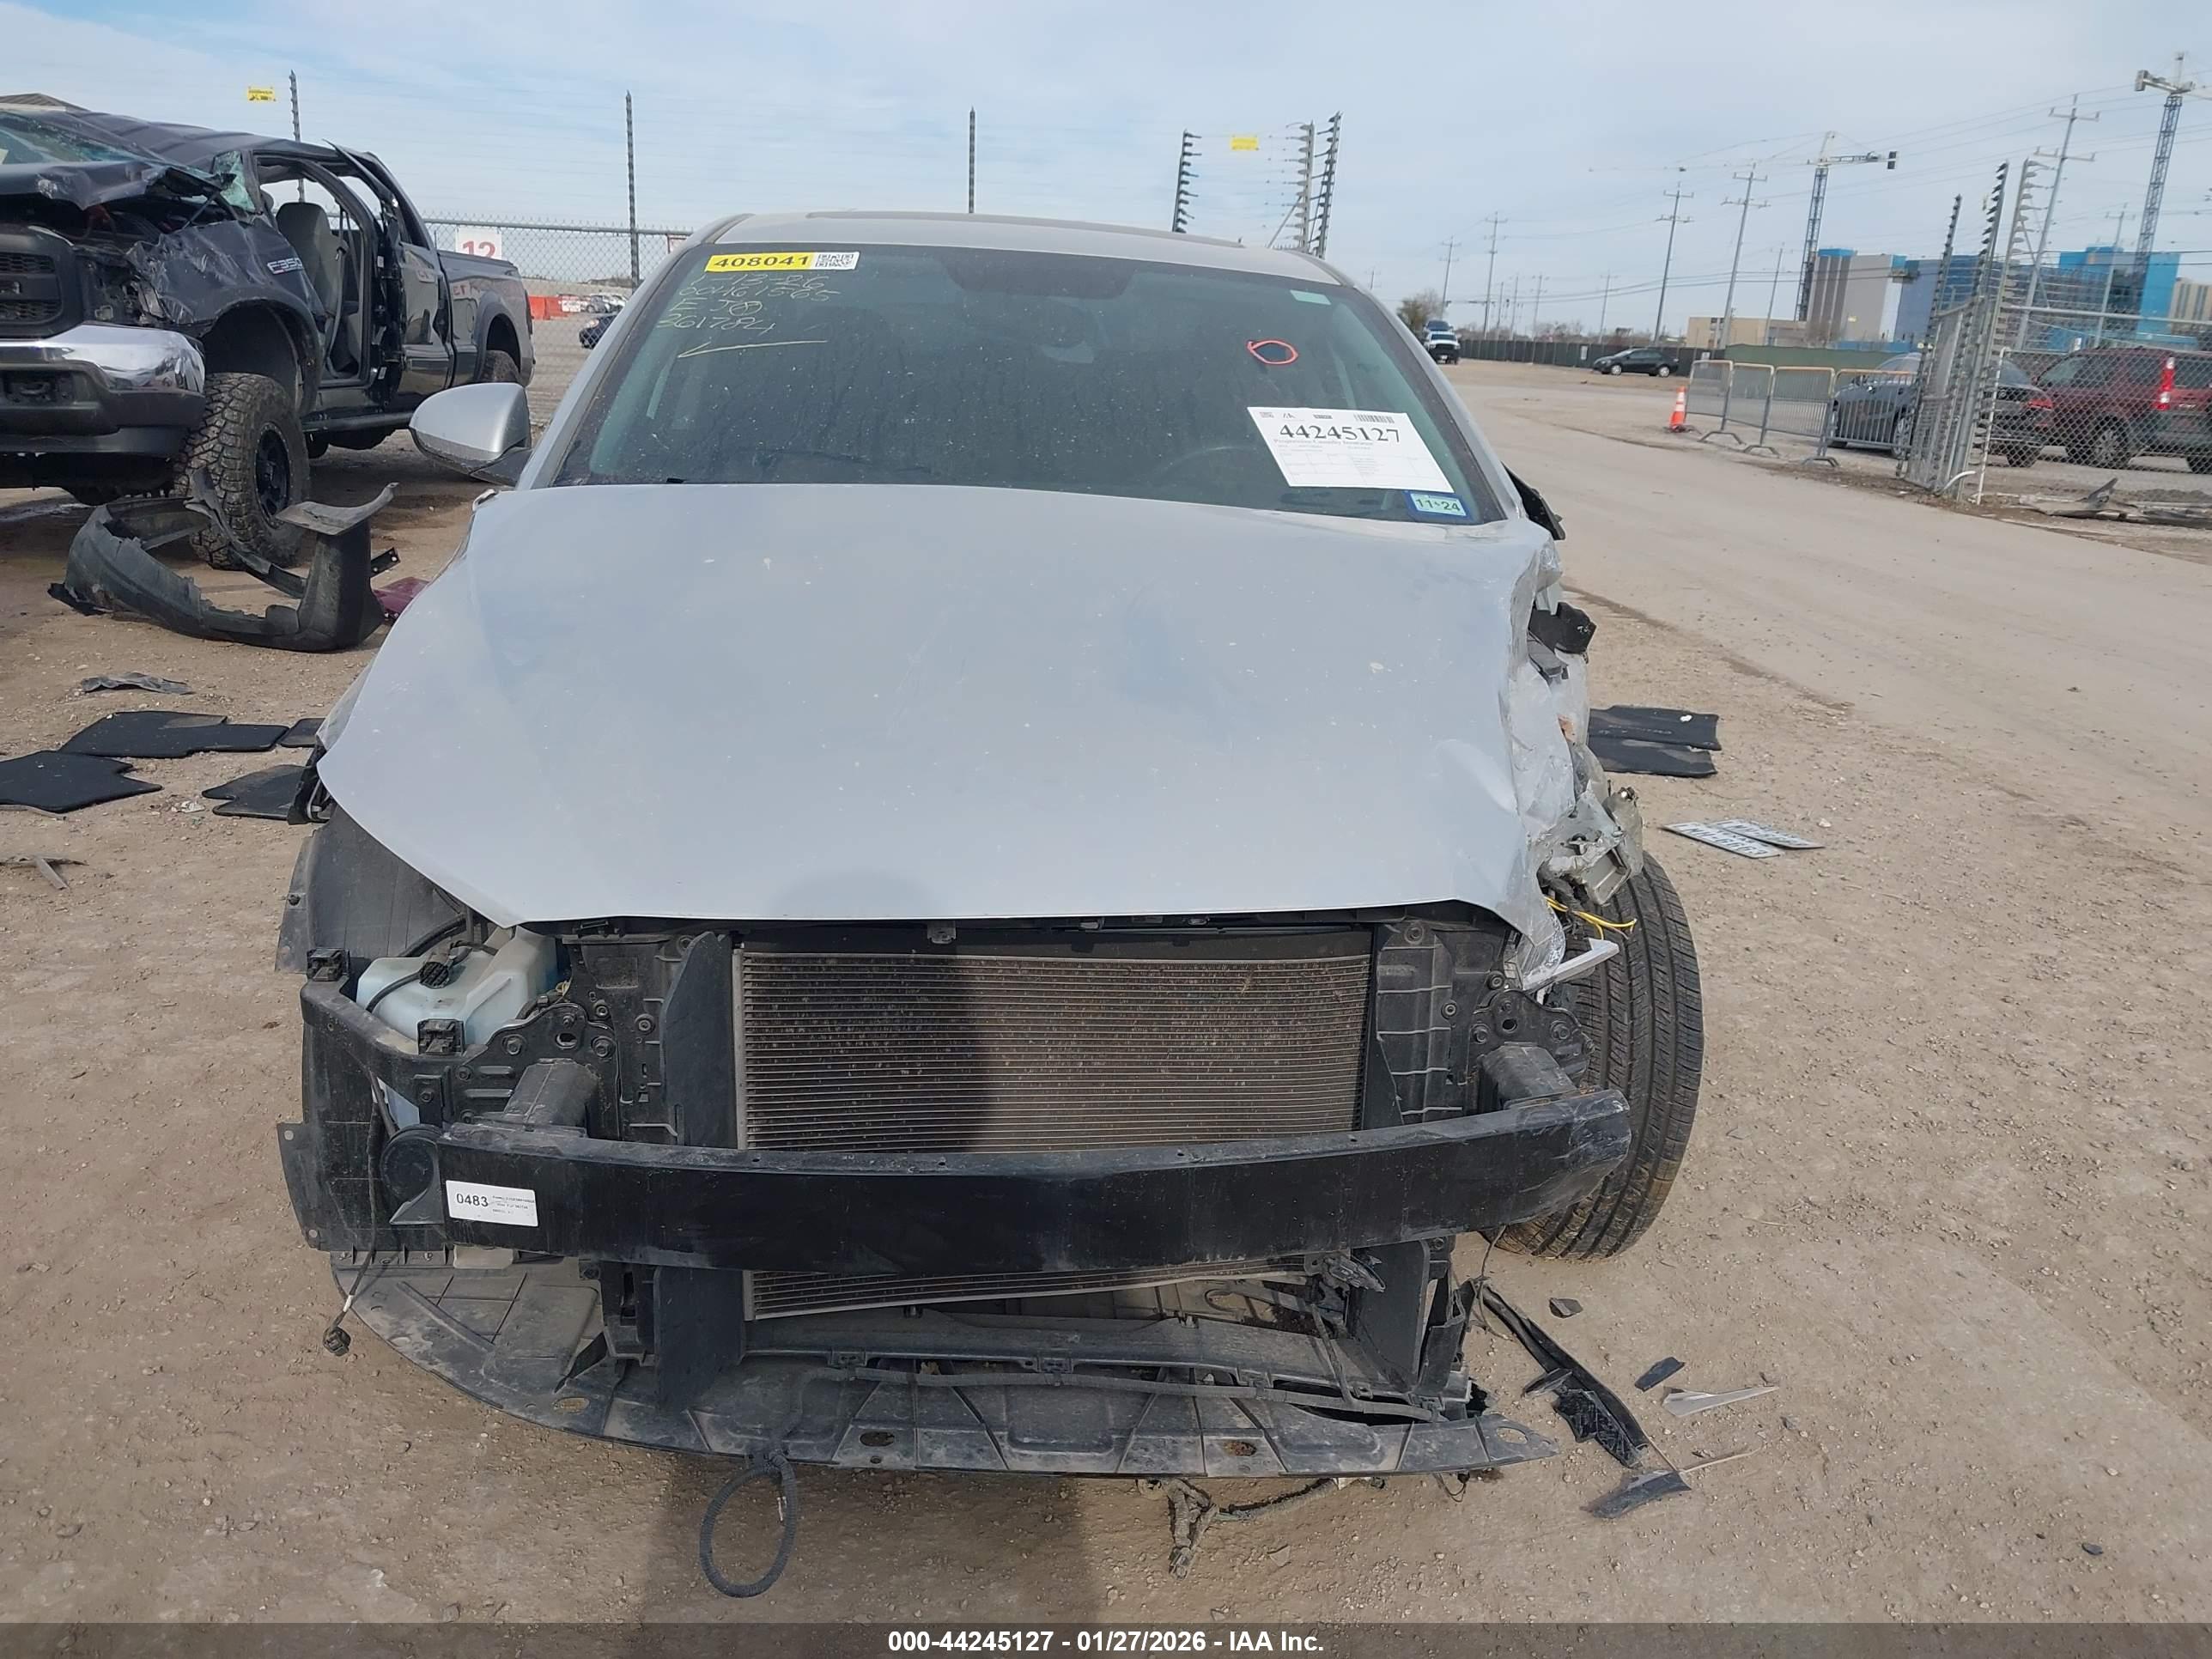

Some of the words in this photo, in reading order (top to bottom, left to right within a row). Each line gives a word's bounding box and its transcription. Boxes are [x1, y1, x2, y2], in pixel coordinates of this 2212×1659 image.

[462, 240, 496, 258] 12
[714, 256, 810, 268] 408041
[1279, 424, 1400, 443] 44245127
[456, 1194, 489, 1207] 0483
